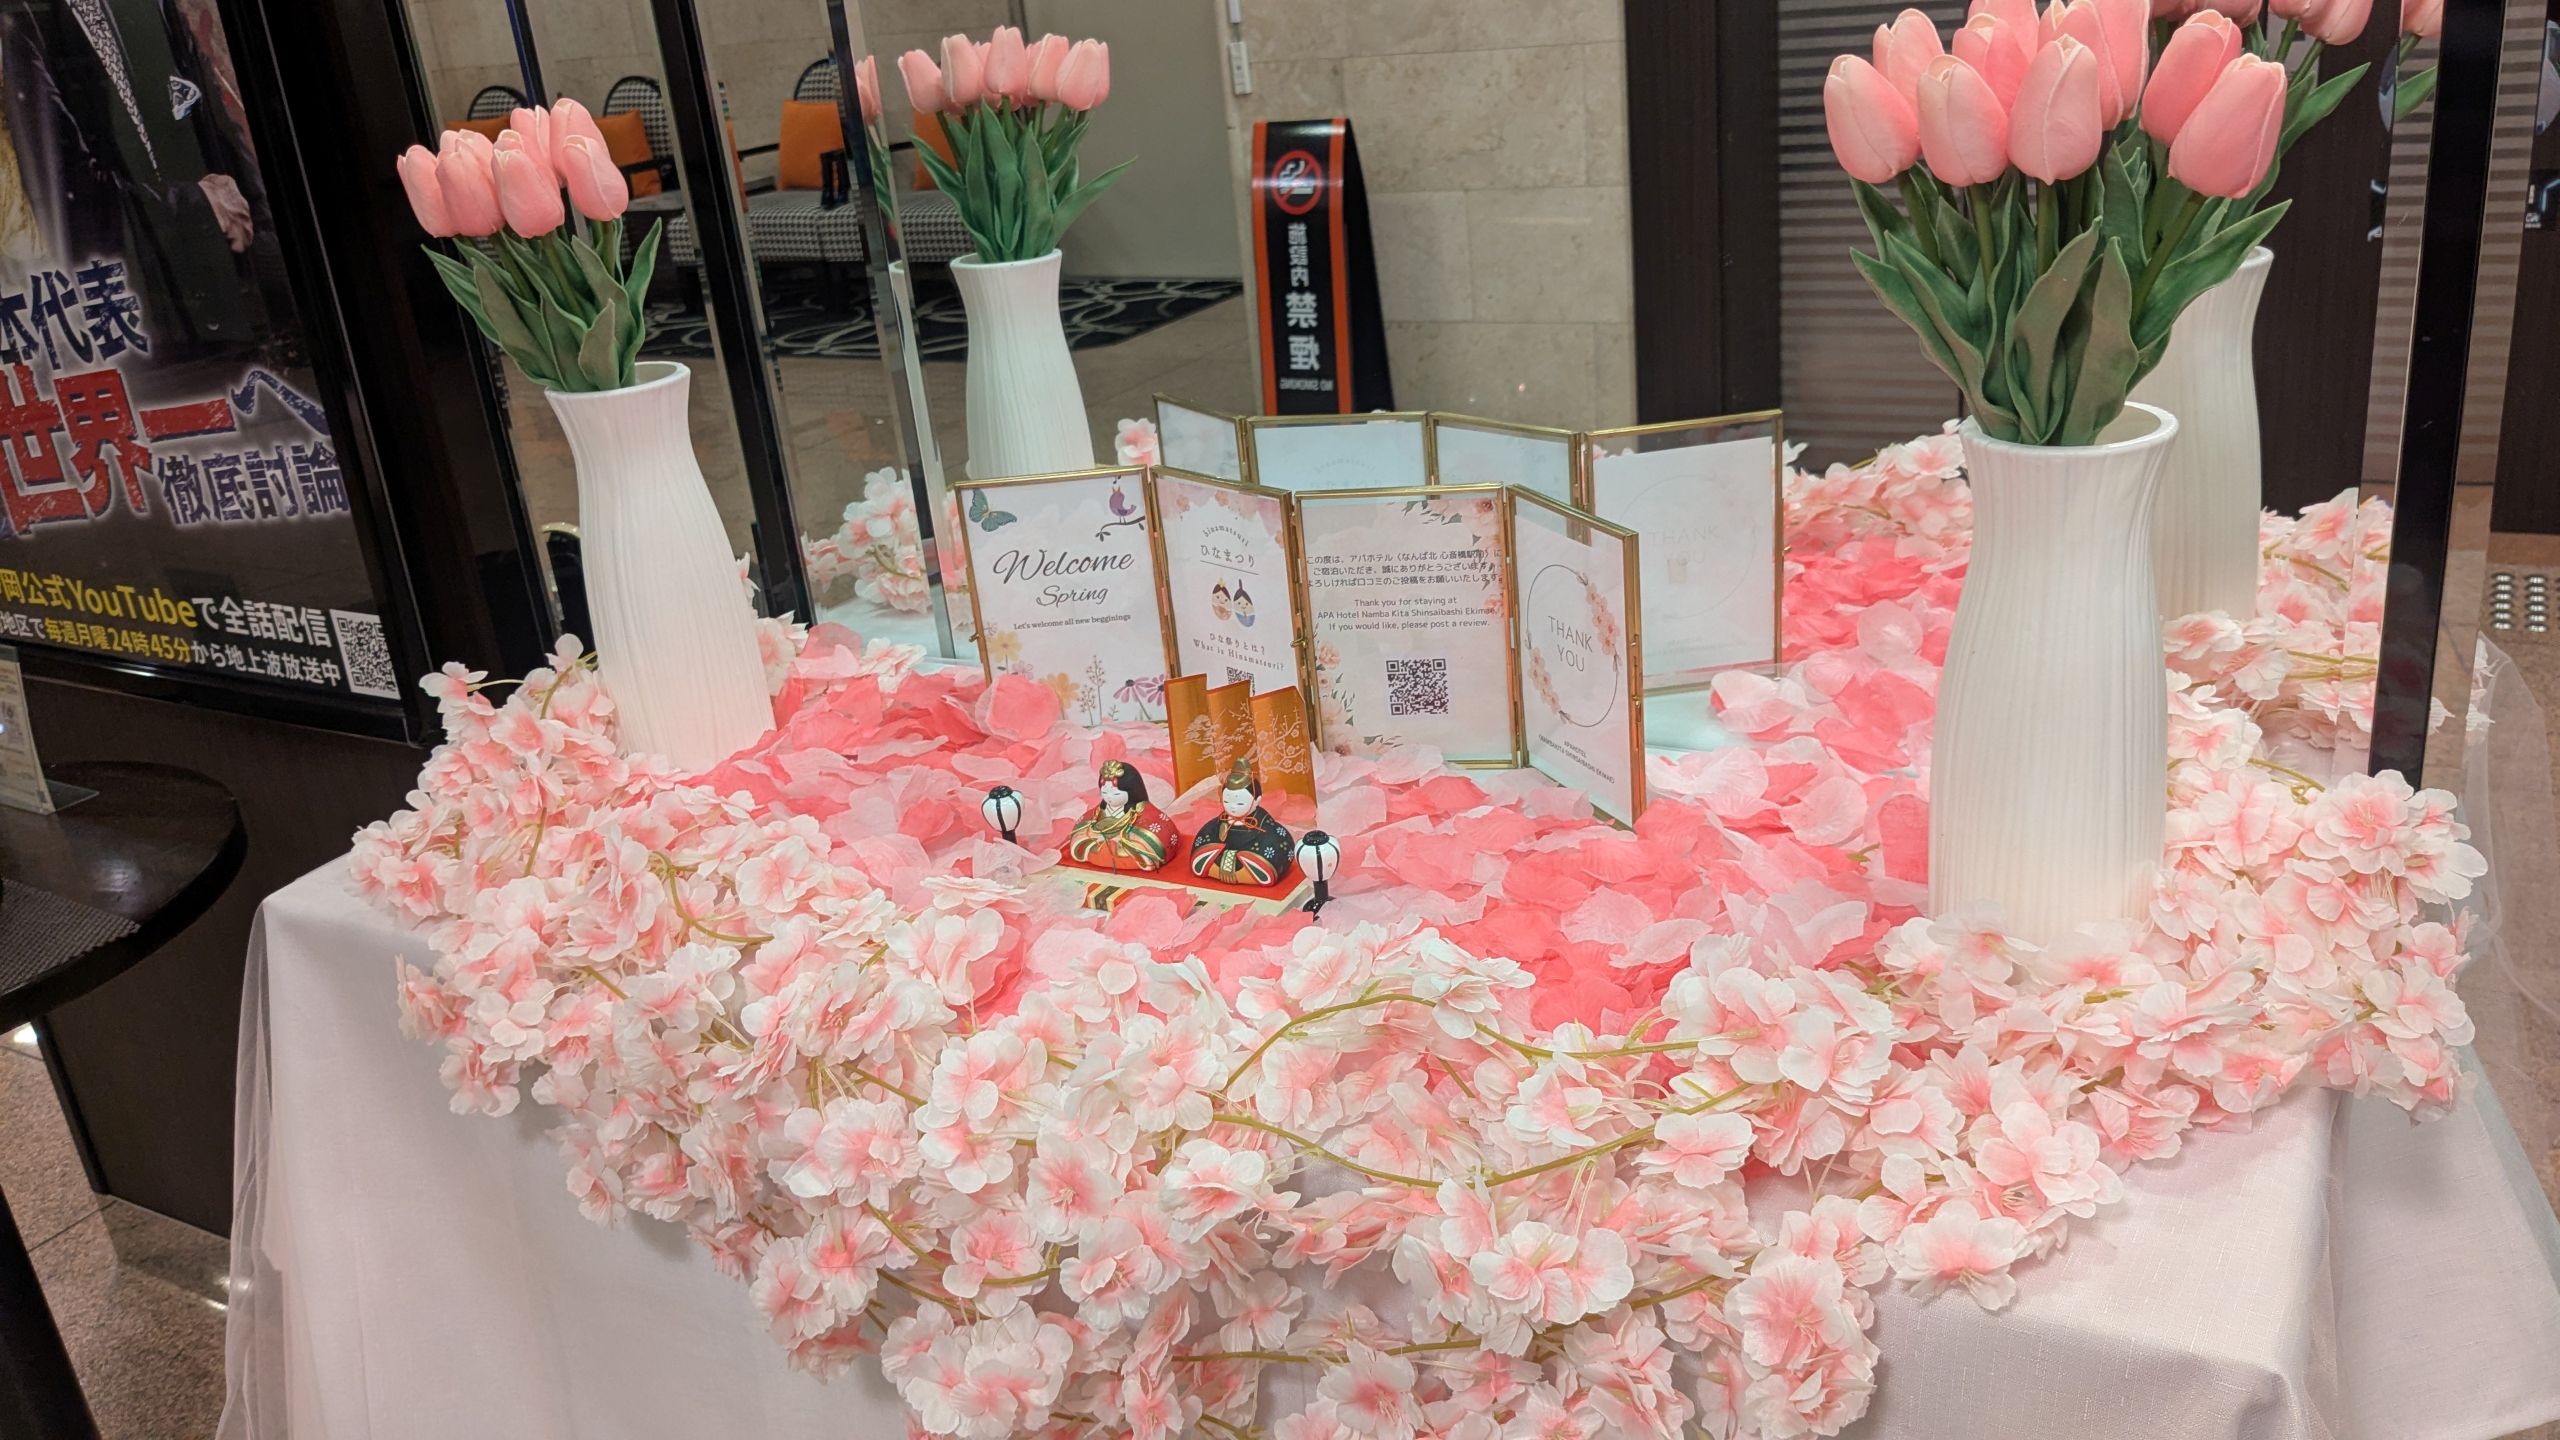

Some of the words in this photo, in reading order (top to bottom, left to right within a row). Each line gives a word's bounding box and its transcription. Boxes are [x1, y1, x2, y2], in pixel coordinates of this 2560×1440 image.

[157, 441, 349, 525] 徹底討論
[1203, 523, 1249, 547] hinamatsuri
[993, 549, 1135, 584] Welcome
[1200, 544, 1254, 568] ひなまつり
[0, 568, 333, 648] 岡公式YouTubeで全話配信
[1036, 585, 1109, 608] Spring
[1355, 599, 1379, 607] Thank
[1381, 600, 1397, 608] you
[1399, 598, 1411, 606] for
[1413, 597, 1446, 607] staying
[1032, 619, 1063, 628] welcome
[1064, 618, 1074, 626] all
[1336, 610, 1359, 618] Hotel
[1362, 610, 1390, 618] Namba
[1392, 609, 1409, 617] Kita
[1412, 608, 1463, 617] Shinsaibashi
[1338, 624, 1353, 632] you
[1355, 622, 1380, 630] would
[1382, 621, 1400, 630] like,
[1401, 621, 1428, 631] please
[1430, 621, 1449, 630] post
[1459, 620, 1491, 628] review.
[1548, 615, 1592, 653] THANK
[1193, 638, 1214, 652] What
[1217, 646, 1224, 655] is
[1228, 648, 1284, 671] Hinamatsuri?
[1557, 644, 1585, 672] YOU
